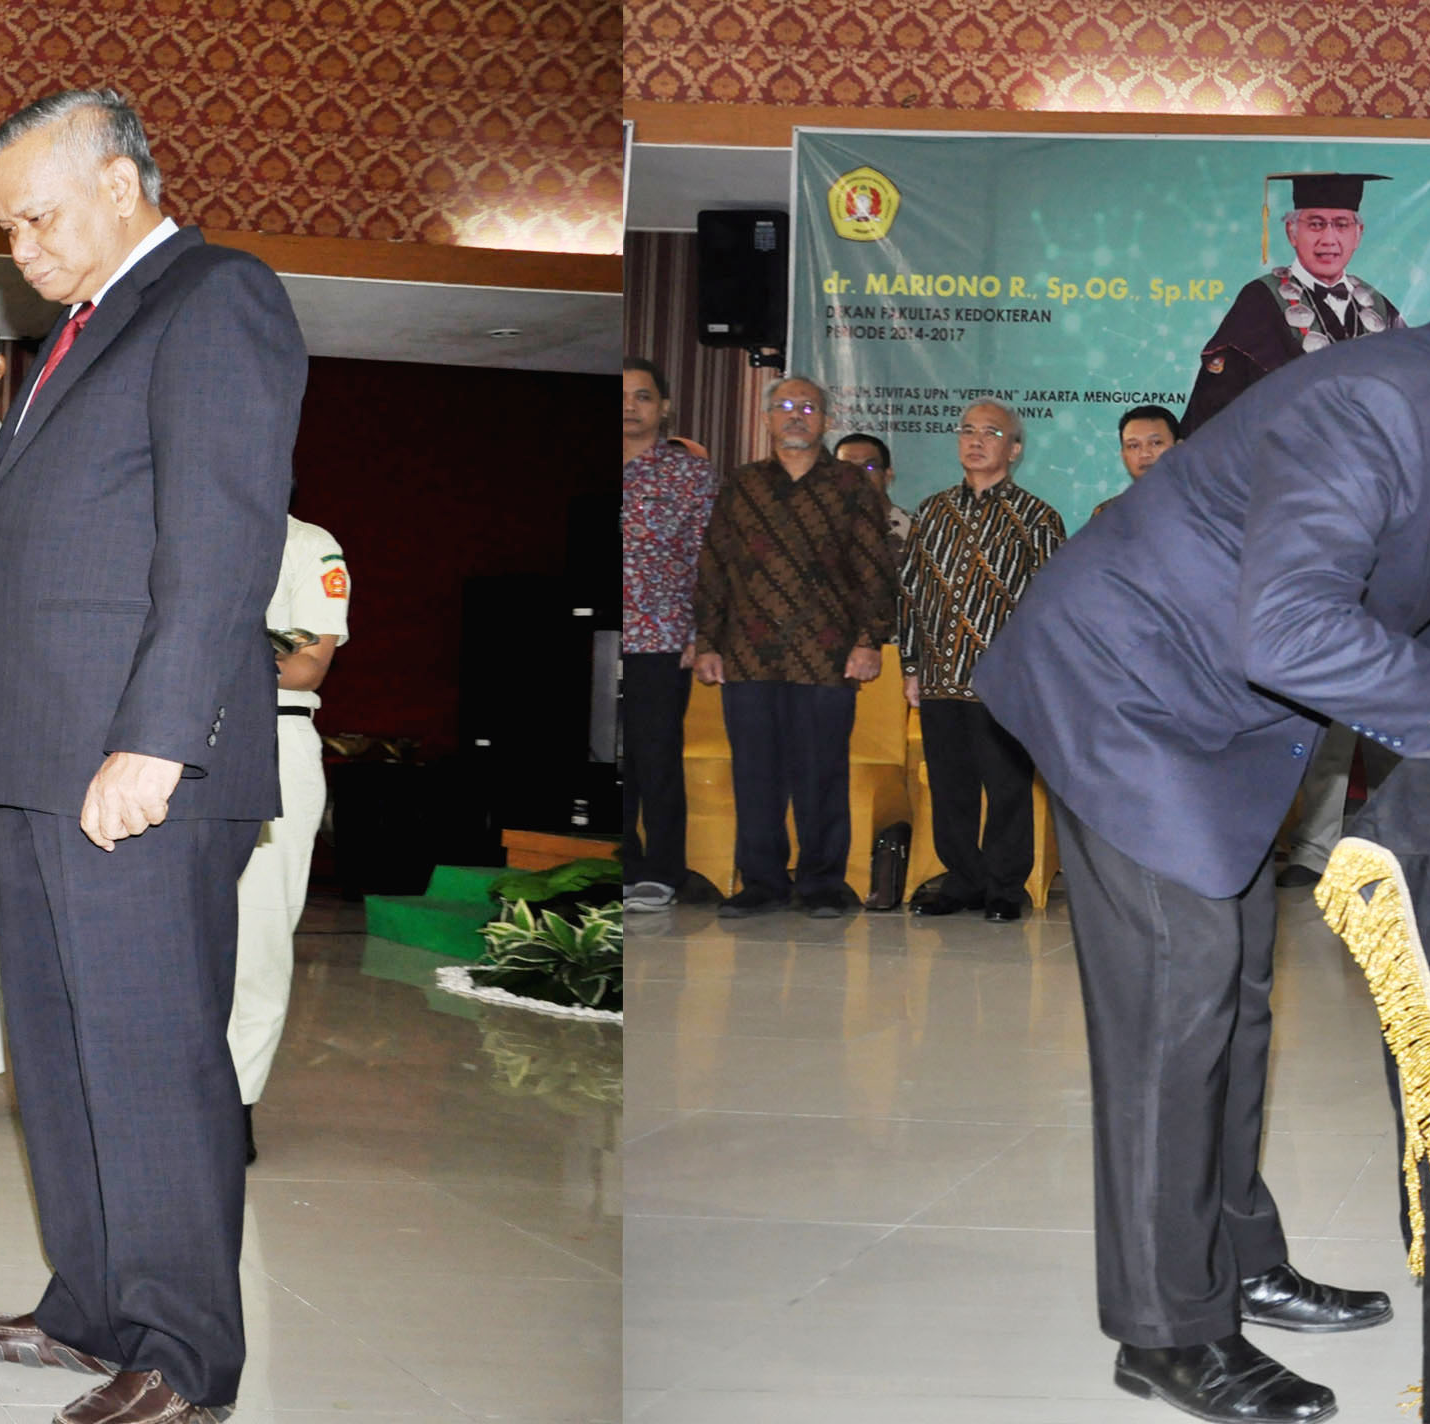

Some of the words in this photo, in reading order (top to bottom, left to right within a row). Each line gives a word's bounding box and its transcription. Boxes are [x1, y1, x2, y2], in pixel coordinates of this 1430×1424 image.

[823, 271, 856, 294] dr.
[865, 274, 1001, 297] MARIONO
[1149, 279, 1230, 307] Sp.KP.
[955, 308, 1051, 322] KEDOKTERAN
[875, 387, 920, 399] SIVITAS
[924, 388, 949, 399] UPN
[1023, 389, 1080, 402] JAKARTA
[1084, 391, 1186, 404] MENGUCAPKAN
[907, 405, 940, 416] ATAS
